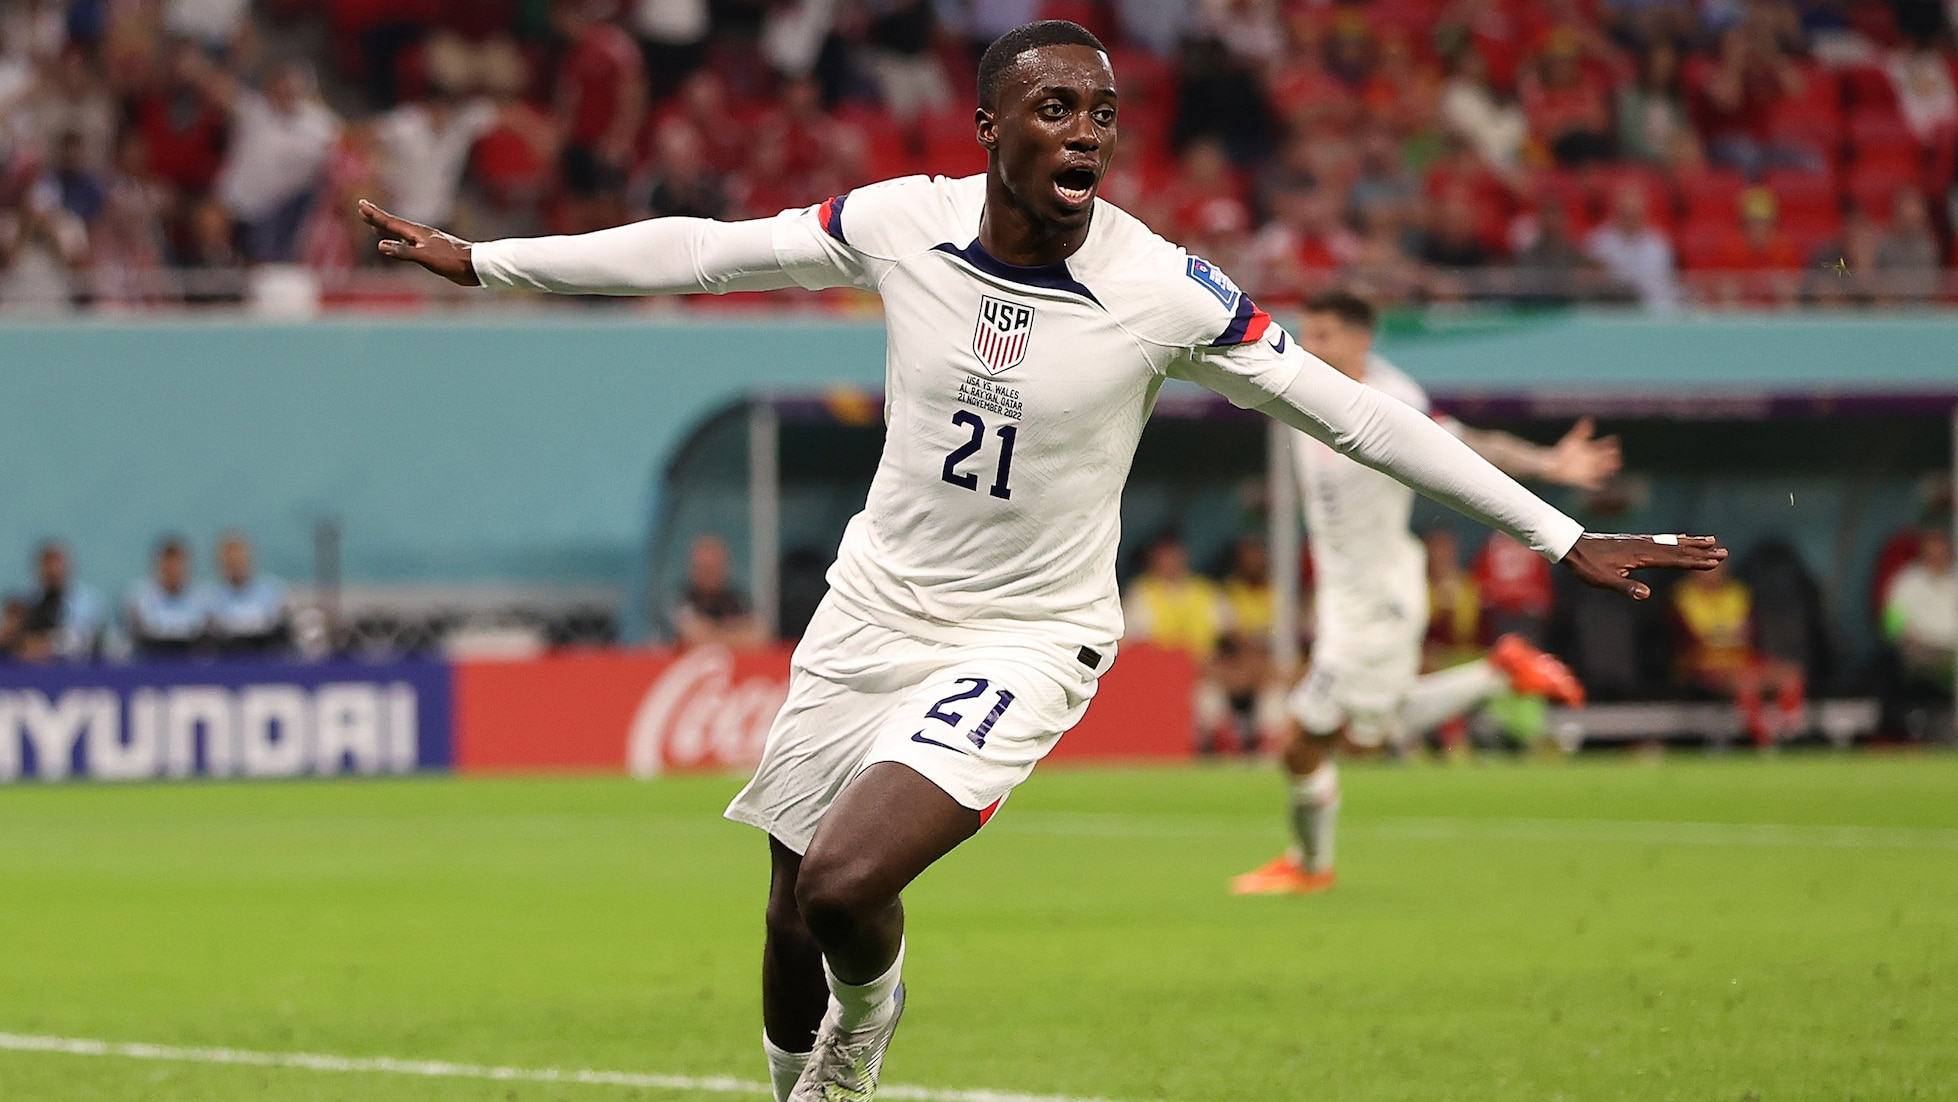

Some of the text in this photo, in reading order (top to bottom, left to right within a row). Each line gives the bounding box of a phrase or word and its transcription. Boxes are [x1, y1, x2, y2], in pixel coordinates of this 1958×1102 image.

[984, 300, 1030, 332] USA
[959, 384, 969, 394] AL
[1000, 397, 1023, 412] QATAR
[967, 375, 980, 387] USA
[995, 385, 1019, 399] WALES
[958, 393, 1022, 421] 21 NOVEMBER 2022
[942, 409, 1017, 500] 21
[924, 677, 1015, 750] 21
